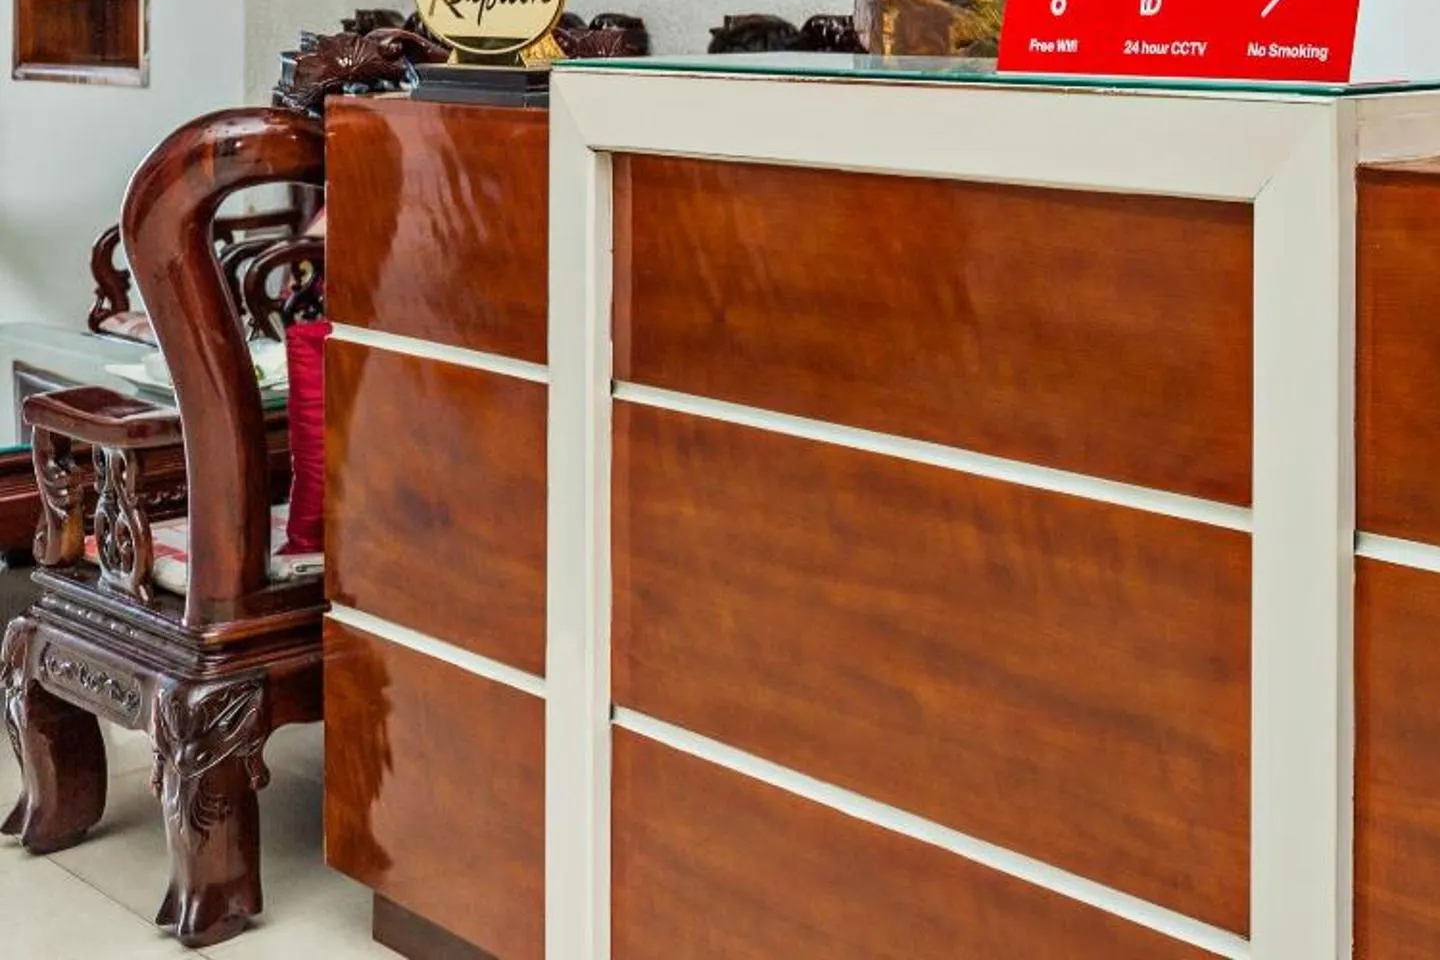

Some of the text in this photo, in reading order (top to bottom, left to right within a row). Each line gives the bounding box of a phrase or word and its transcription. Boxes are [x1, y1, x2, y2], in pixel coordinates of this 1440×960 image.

[1029, 38, 1055, 53] Free
[1123, 40, 1208, 56] 24 hour CCTV
[1247, 41, 1330, 62] No Smoking
